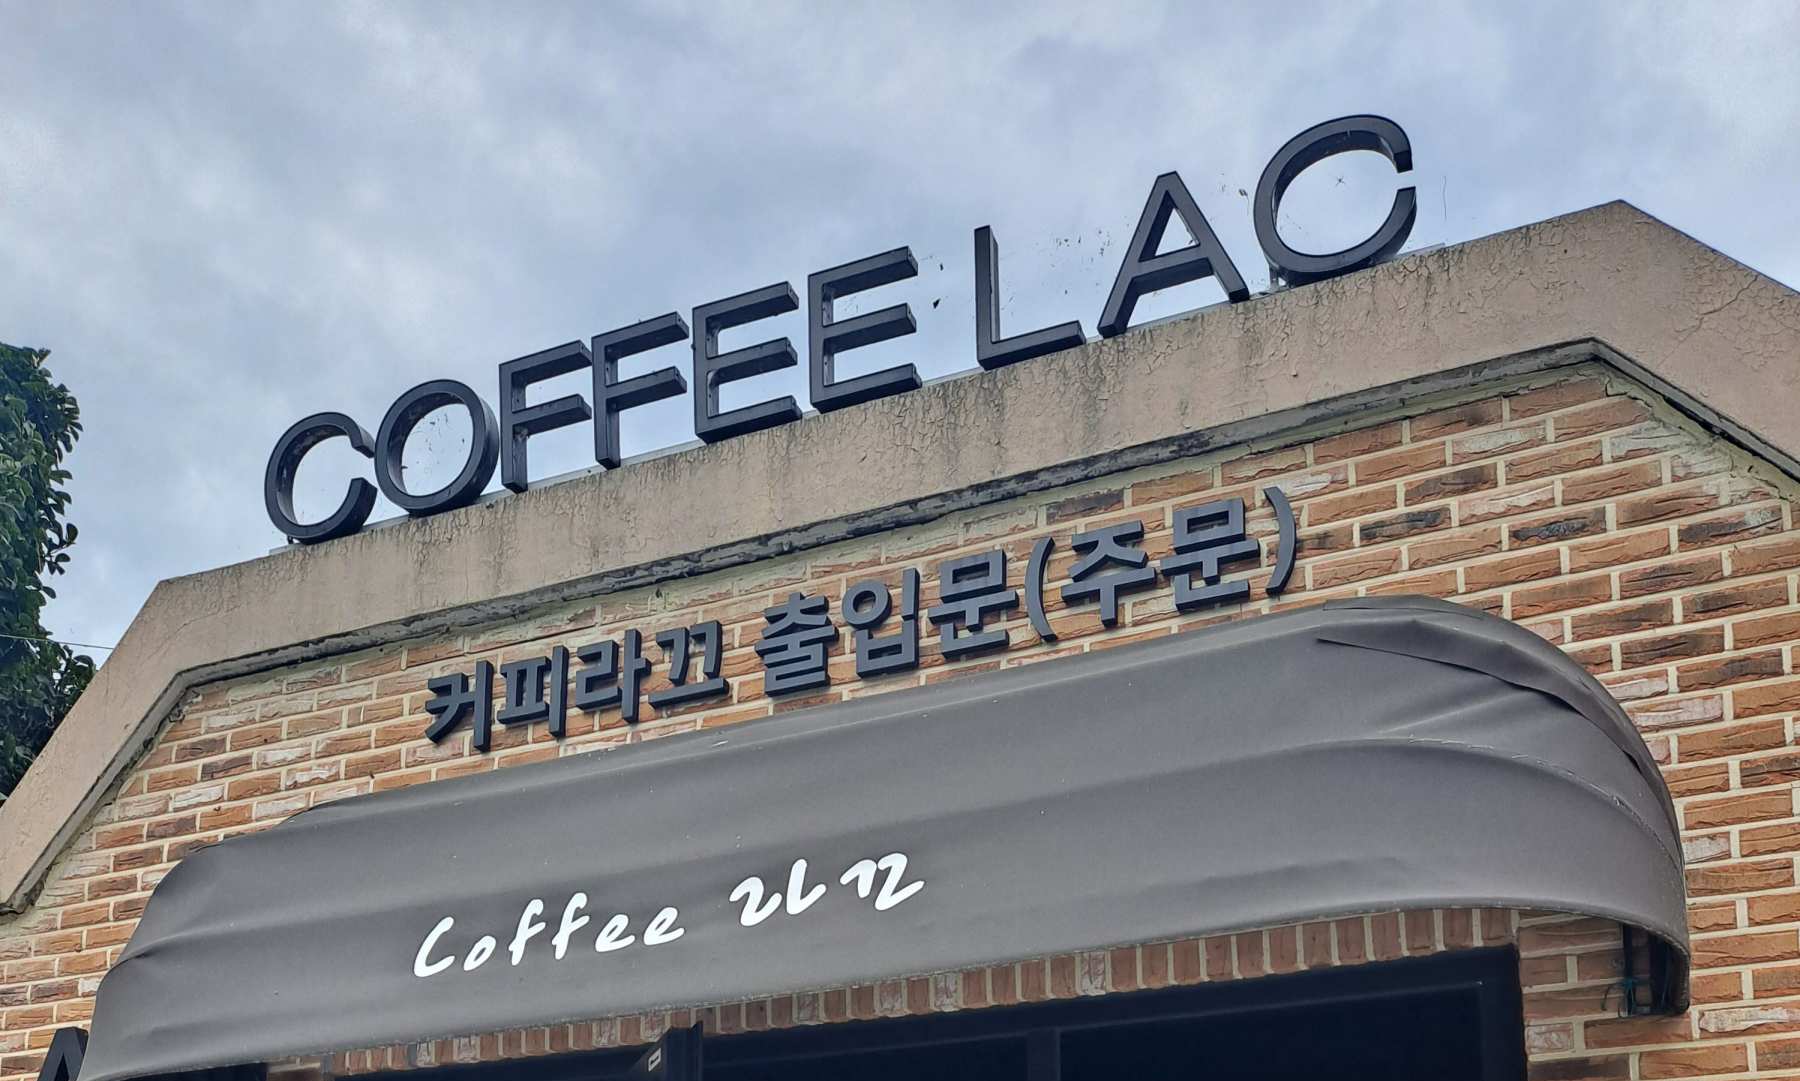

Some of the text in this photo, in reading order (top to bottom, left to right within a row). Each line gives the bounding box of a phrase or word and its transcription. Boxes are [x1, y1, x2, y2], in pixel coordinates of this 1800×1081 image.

[264, 114, 1417, 545] COFFEE LAC
[425, 486, 1297, 751] 커피라끄 출입문(주문)
[413, 892, 685, 977] Coffee
